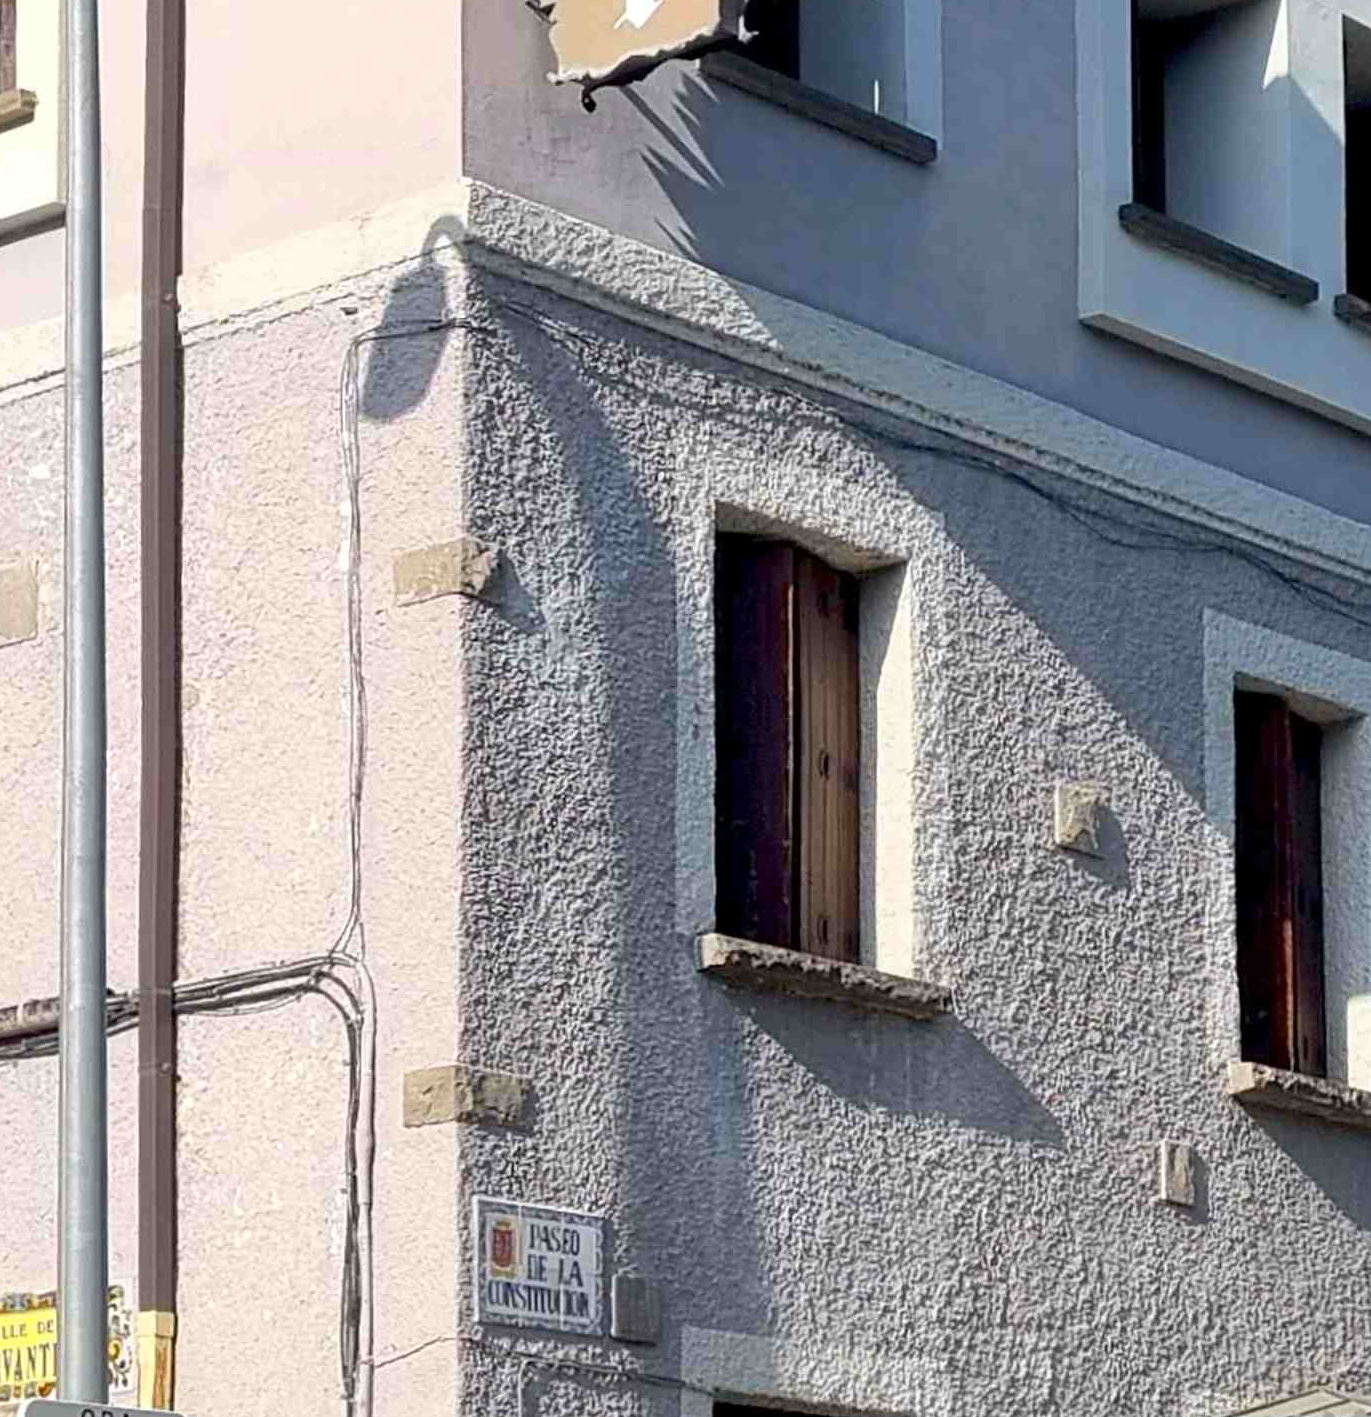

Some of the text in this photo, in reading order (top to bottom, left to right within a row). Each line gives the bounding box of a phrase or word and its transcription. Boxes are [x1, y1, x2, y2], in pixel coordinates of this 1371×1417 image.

[529, 1224, 581, 1256] PASEO
[527, 1254, 584, 1287] DE LA
[37, 1320, 55, 1335] DE
